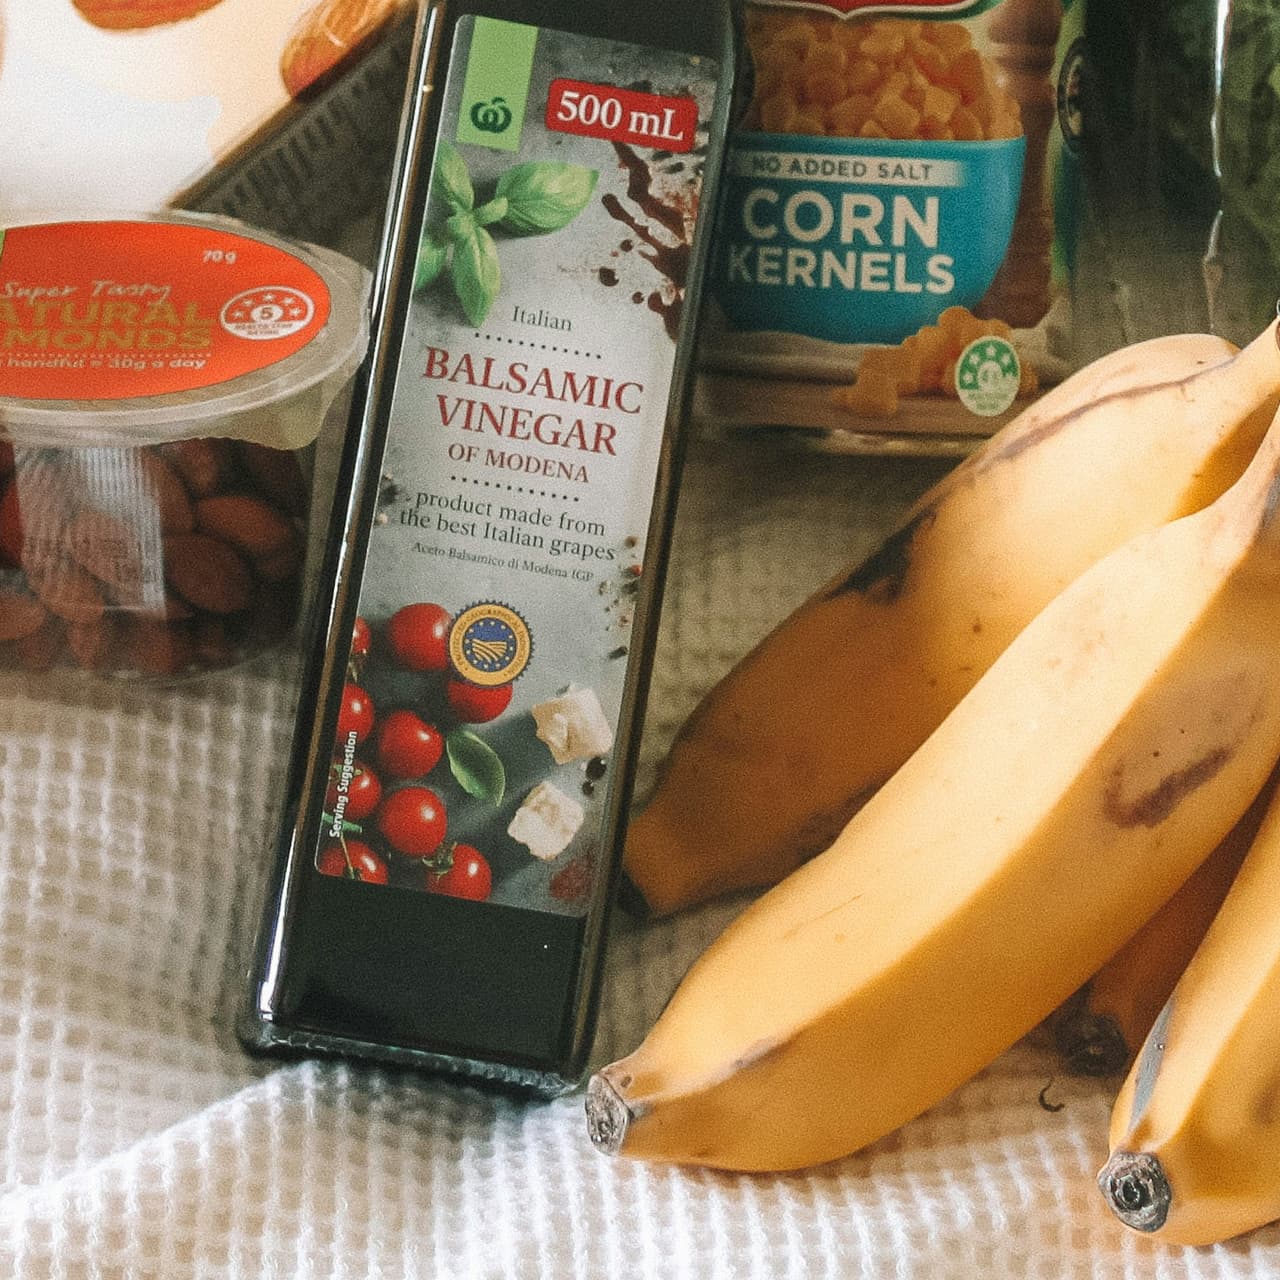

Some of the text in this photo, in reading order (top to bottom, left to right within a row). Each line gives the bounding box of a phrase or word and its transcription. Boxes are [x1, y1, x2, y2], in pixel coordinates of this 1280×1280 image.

[556, 90, 684, 142] 500 mL
[752, 157, 933, 181] NO ADDED SALT
[742, 188, 940, 249] CORN
[727, 244, 956, 295] KERNELS
[0, 280, 172, 307] Super Tasty
[261, 307, 273, 320] 5
[512, 304, 573, 333] Italian
[7, 355, 84, 369] handful
[169, 358, 207, 371] day
[423, 345, 645, 416] BALSAMIC
[435, 393, 618, 457] VINEGAR
[448, 442, 589, 483] OF MODENA
[400, 507, 618, 562] the best Italian grapes
[416, 492, 606, 537] product made from
[411, 541, 447, 557] Aceto
[449, 547, 506, 568] Balsamico
[508, 557, 520, 570] di
[523, 560, 568, 579] Modena
[328, 731, 358, 838] Serving Suggestion
